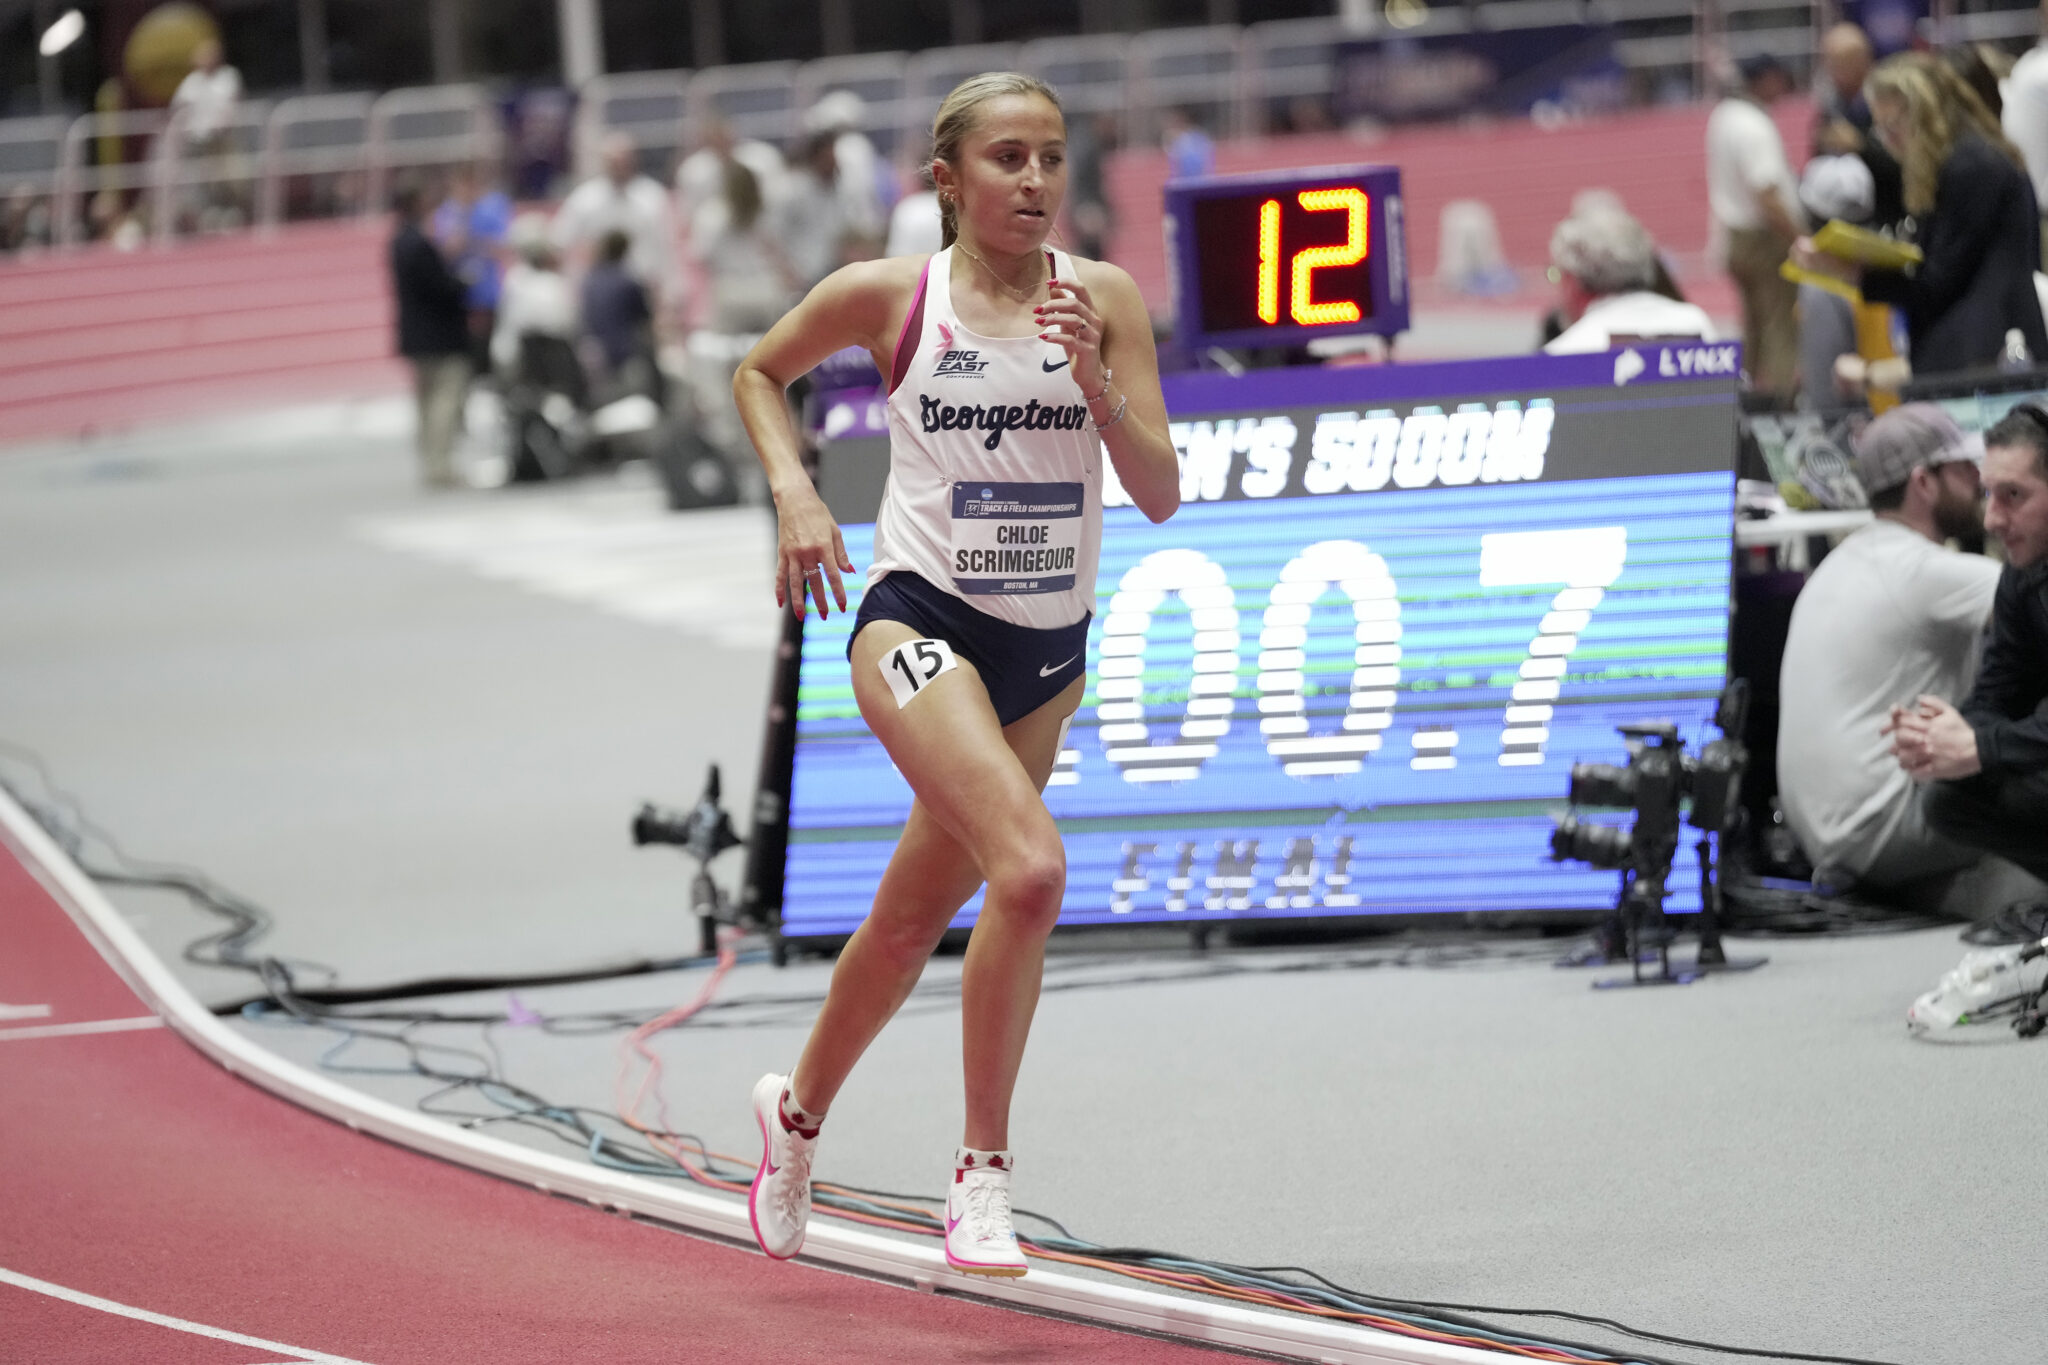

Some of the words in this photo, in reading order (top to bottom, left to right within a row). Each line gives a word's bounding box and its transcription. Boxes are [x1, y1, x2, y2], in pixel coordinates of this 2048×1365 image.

[1258, 188, 1368, 325] 12
[936, 361, 990, 371] EAST
[942, 350, 980, 361] BIG
[1659, 345, 1737, 377] LYNX
[919, 394, 1087, 450] Georgetown
[1102, 416, 1298, 505] N'S
[1304, 397, 1555, 494] 5000M
[980, 504, 1002, 512] TRACK
[1003, 504, 1009, 512] &
[1009, 504, 1026, 512] FIELD
[1028, 503, 1077, 512] CHAMPIONSHIPS
[996, 525, 1049, 544] CHLOE
[956, 546, 1075, 573] SCRIMGEOUR
[1003, 581, 1028, 590] BOSTON,
[1029, 581, 1039, 589] MA
[892, 641, 943, 692] 15
[1110, 834, 1362, 914] FINAL
